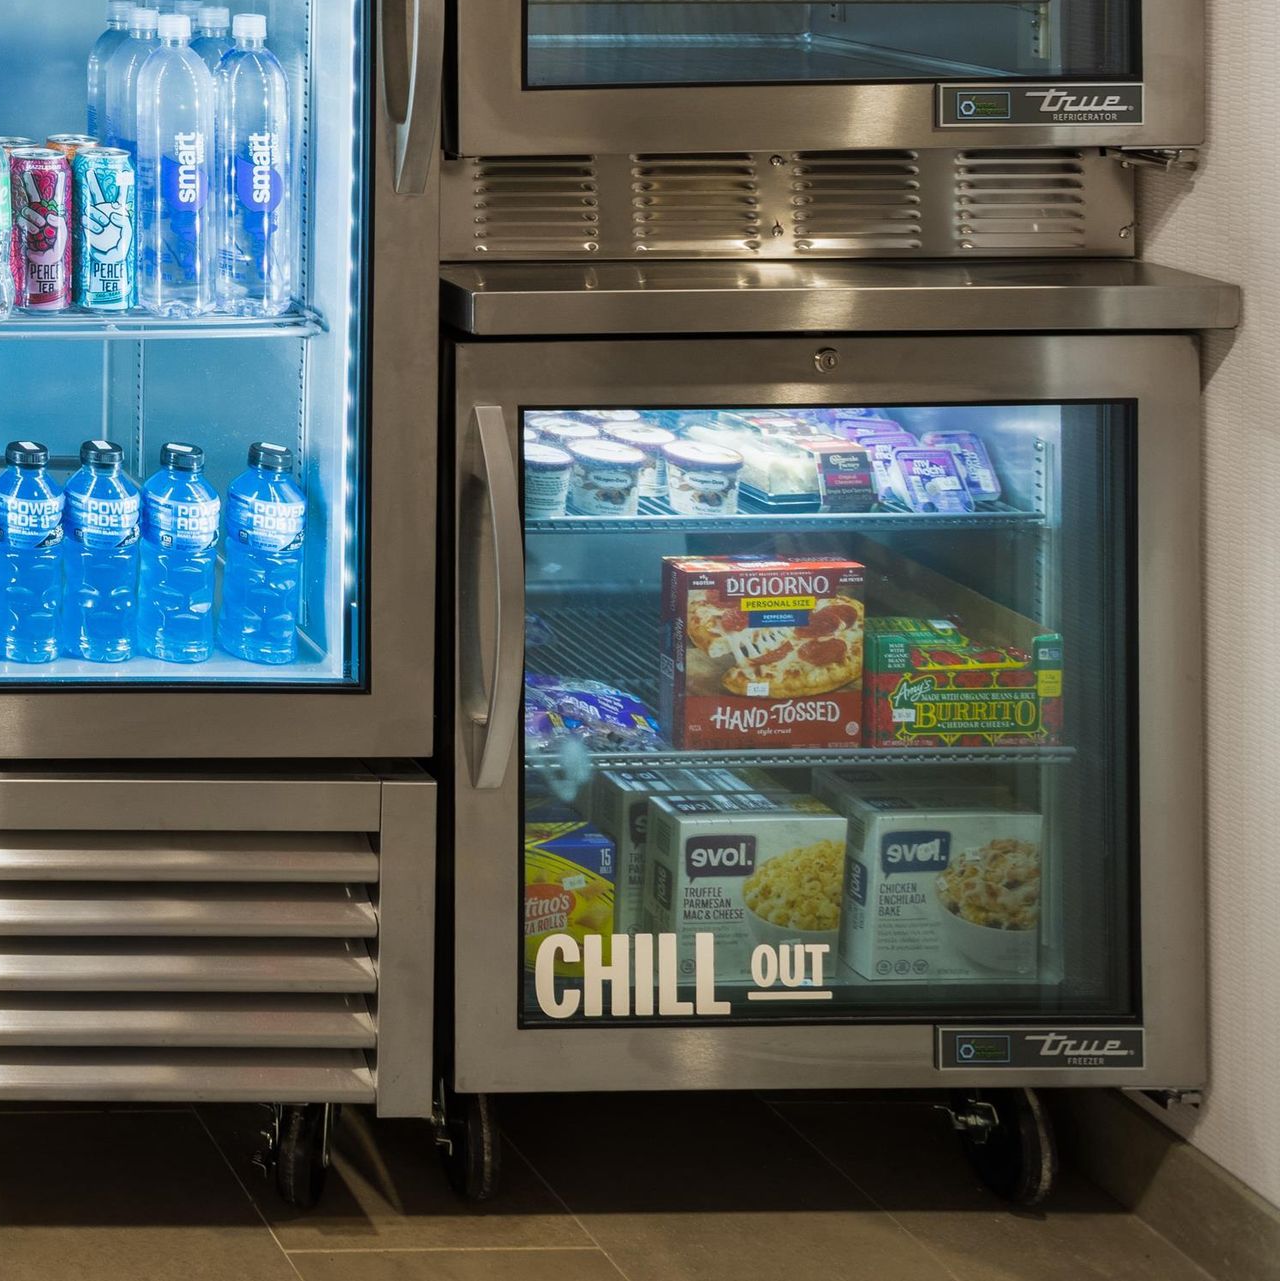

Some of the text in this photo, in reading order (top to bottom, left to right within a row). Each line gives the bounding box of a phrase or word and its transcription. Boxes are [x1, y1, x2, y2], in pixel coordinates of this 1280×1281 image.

[1025, 89, 1128, 112] true
[1053, 113, 1118, 121] REFRIGERATOR
[179, 132, 197, 203] smart
[252, 132, 271, 203] smart
[746, 599, 810, 608] PERSONAL SIZE
[921, 693, 940, 701] MADE
[913, 700, 1036, 728] BURRITO
[941, 721, 979, 729] CHEDDAR
[600, 848, 612, 865] 15
[684, 887, 722, 898] TRUFFLE
[683, 898, 732, 908] PARMESAN
[683, 909, 704, 920] MAC
[712, 908, 744, 920] CHEESE
[879, 906, 901, 916] BAKE
[535, 933, 830, 1019] CHILL OUT
[1026, 1032, 1128, 1056] true
[1067, 1057, 1106, 1065] FREEZER
